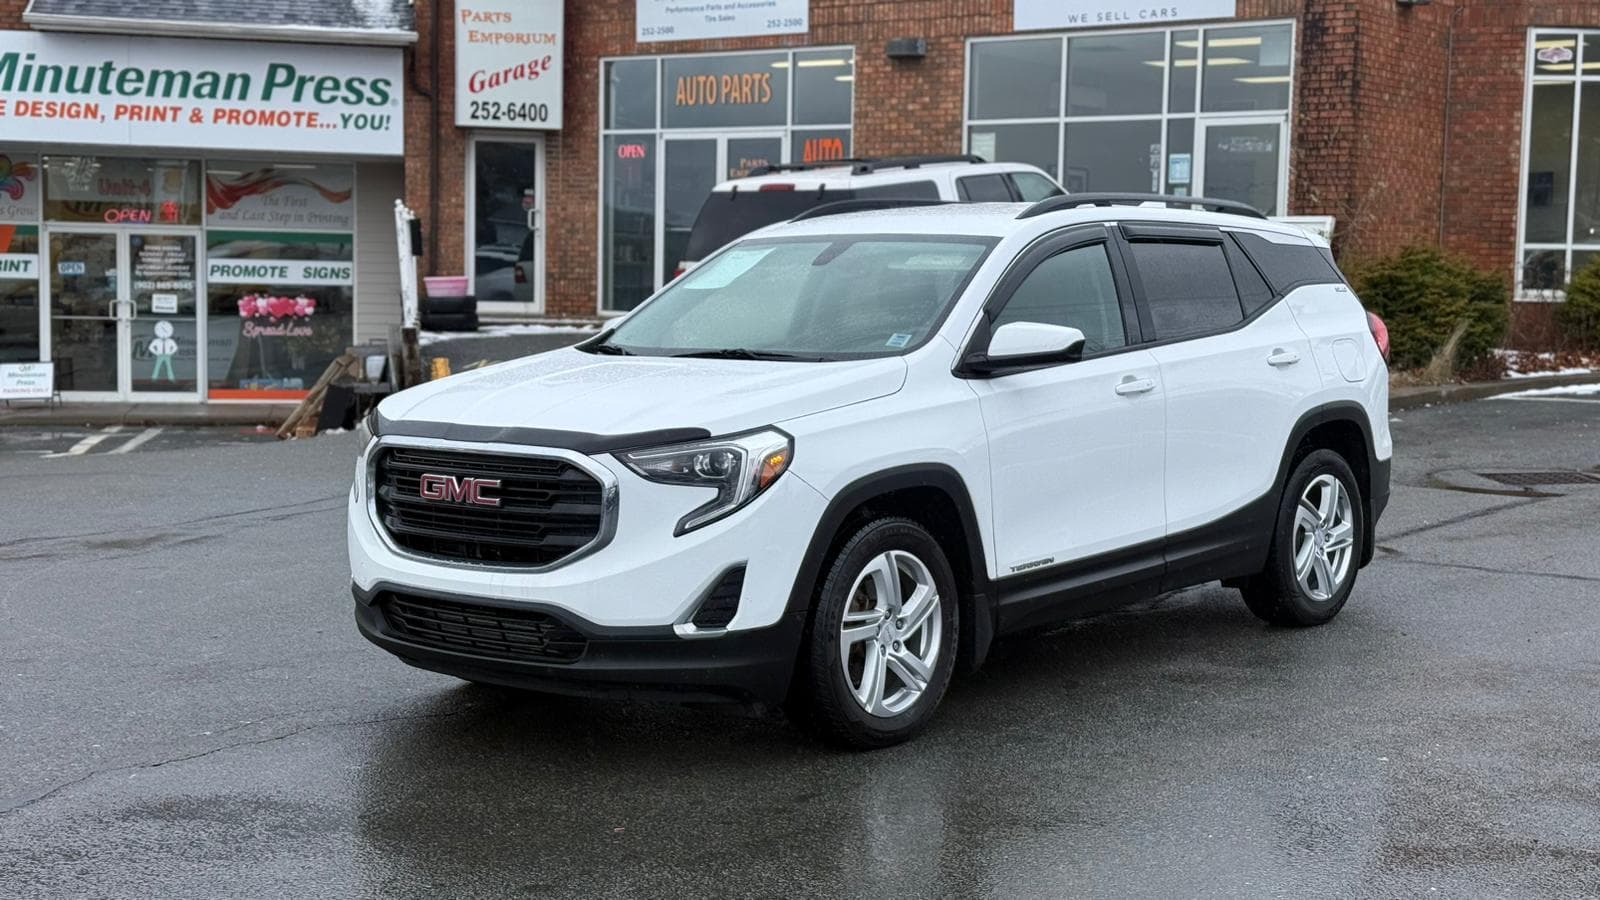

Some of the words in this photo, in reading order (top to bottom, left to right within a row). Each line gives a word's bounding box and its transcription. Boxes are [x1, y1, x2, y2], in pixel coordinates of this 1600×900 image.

[706, 3, 723, 11] Parts
[724, 2, 736, 10] and
[737, 1, 776, 9] Accessories
[461, 9, 512, 24] PARTS
[704, 15, 717, 23] Tire
[718, 14, 735, 22] Sales
[1068, 13, 1088, 23] WE
[1096, 11, 1130, 22] SELL
[1139, 7, 1178, 19] CARS
[468, 30, 556, 45] EMPORIUM
[468, 55, 552, 93] Garage
[675, 75, 718, 106] AUTO
[721, 73, 772, 104] PARTS
[14, 100, 105, 123] DESIGN,
[114, 104, 182, 122] PRINT
[188, 107, 204, 123] &
[470, 101, 549, 122] 252-6400
[618, 145, 645, 159] OPEN
[804, 138, 844, 163] AUTO
[104, 208, 151, 223] OPEN
[267, 209, 291, 225] Step
[294, 210, 304, 221] in
[307, 212, 350, 226] Printing
[0, 260, 32, 273] INT
[61, 263, 82, 273] OPEN
[210, 264, 288, 278] PROMOTE
[303, 266, 351, 280] SIGNS
[243, 321, 285, 337] Spread
[286, 322, 313, 336] Love
[420, 474, 501, 506] GMC
[1010, 556, 1055, 572] TERRAIN
